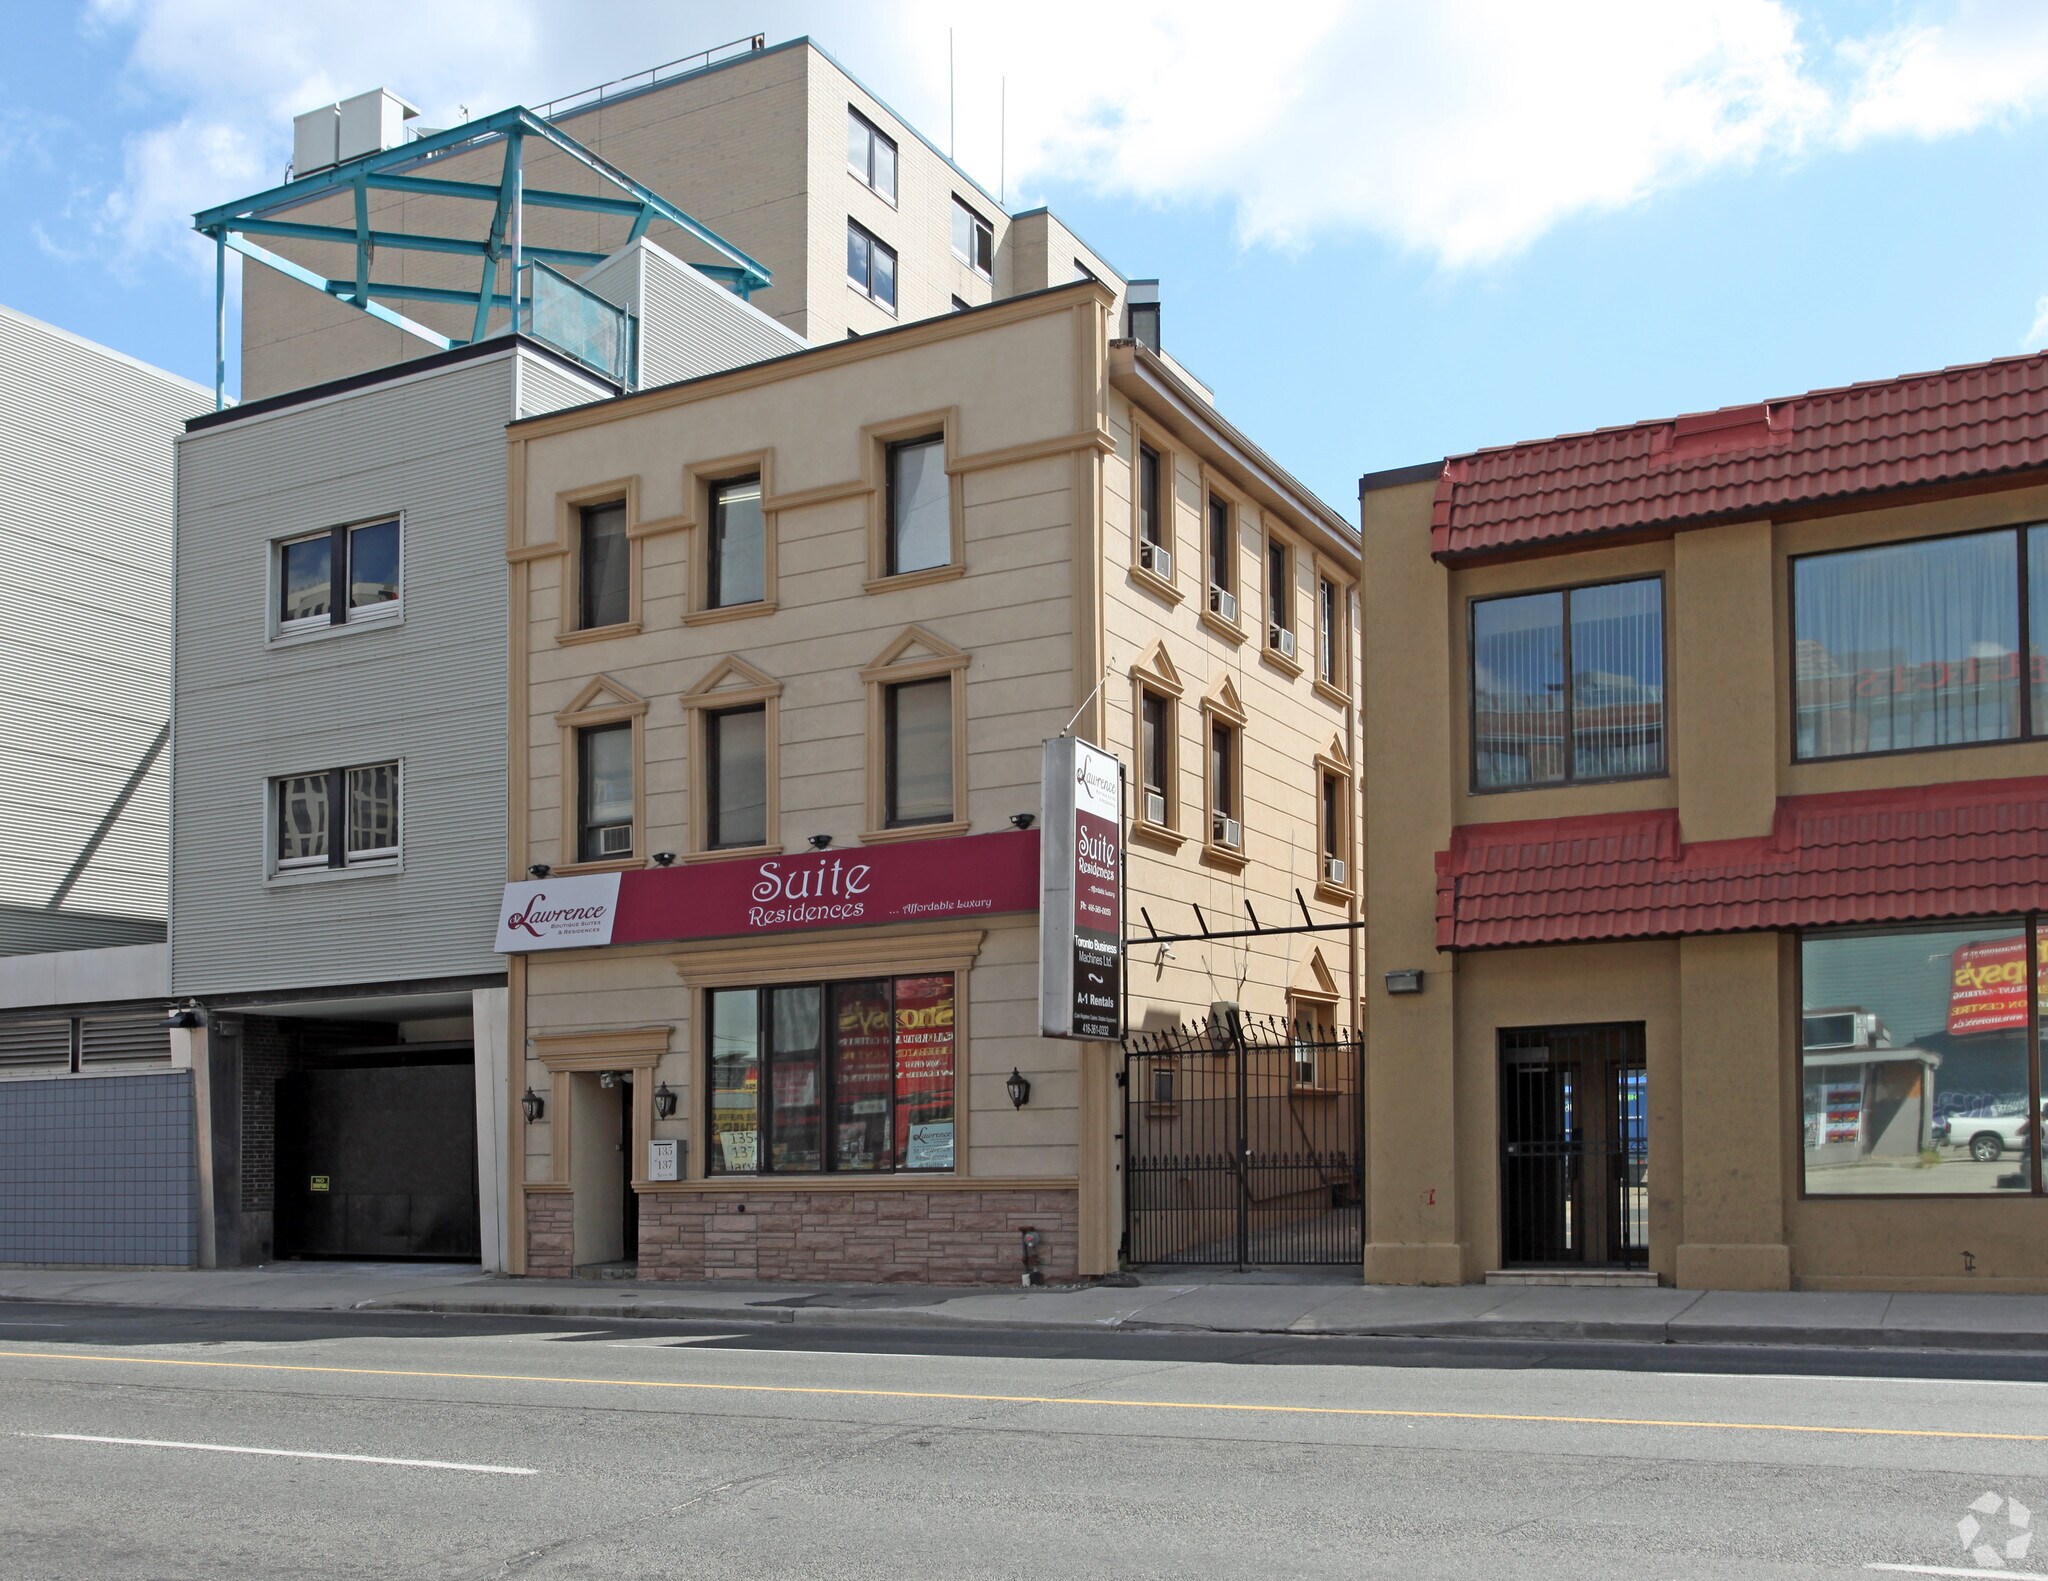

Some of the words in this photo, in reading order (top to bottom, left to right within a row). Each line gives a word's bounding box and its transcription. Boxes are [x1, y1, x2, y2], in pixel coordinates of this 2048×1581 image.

[1077, 755, 1116, 799] Lawrence
[1079, 826, 1115, 868] Suite
[1079, 857, 1115, 881] Residences
[752, 858, 870, 902] Suite
[508, 893, 607, 938] Lawrence
[749, 902, 864, 926] Residences
[903, 901, 954, 914] Affordable
[957, 899, 992, 909] Luxury
[1075, 935, 1093, 950] Toronto
[1094, 939, 1117, 955] Business
[1079, 951, 1102, 966] Machines
[1103, 956, 1113, 967] Ltd.
[1077, 992, 1088, 1004] A-1
[1090, 993, 1114, 1008] Rentals
[913, 1127, 952, 1144] Lawrence
[658, 1146, 672, 1156] 135
[732, 1146, 755, 1158] 137
[658, 1160, 672, 1169] 137
